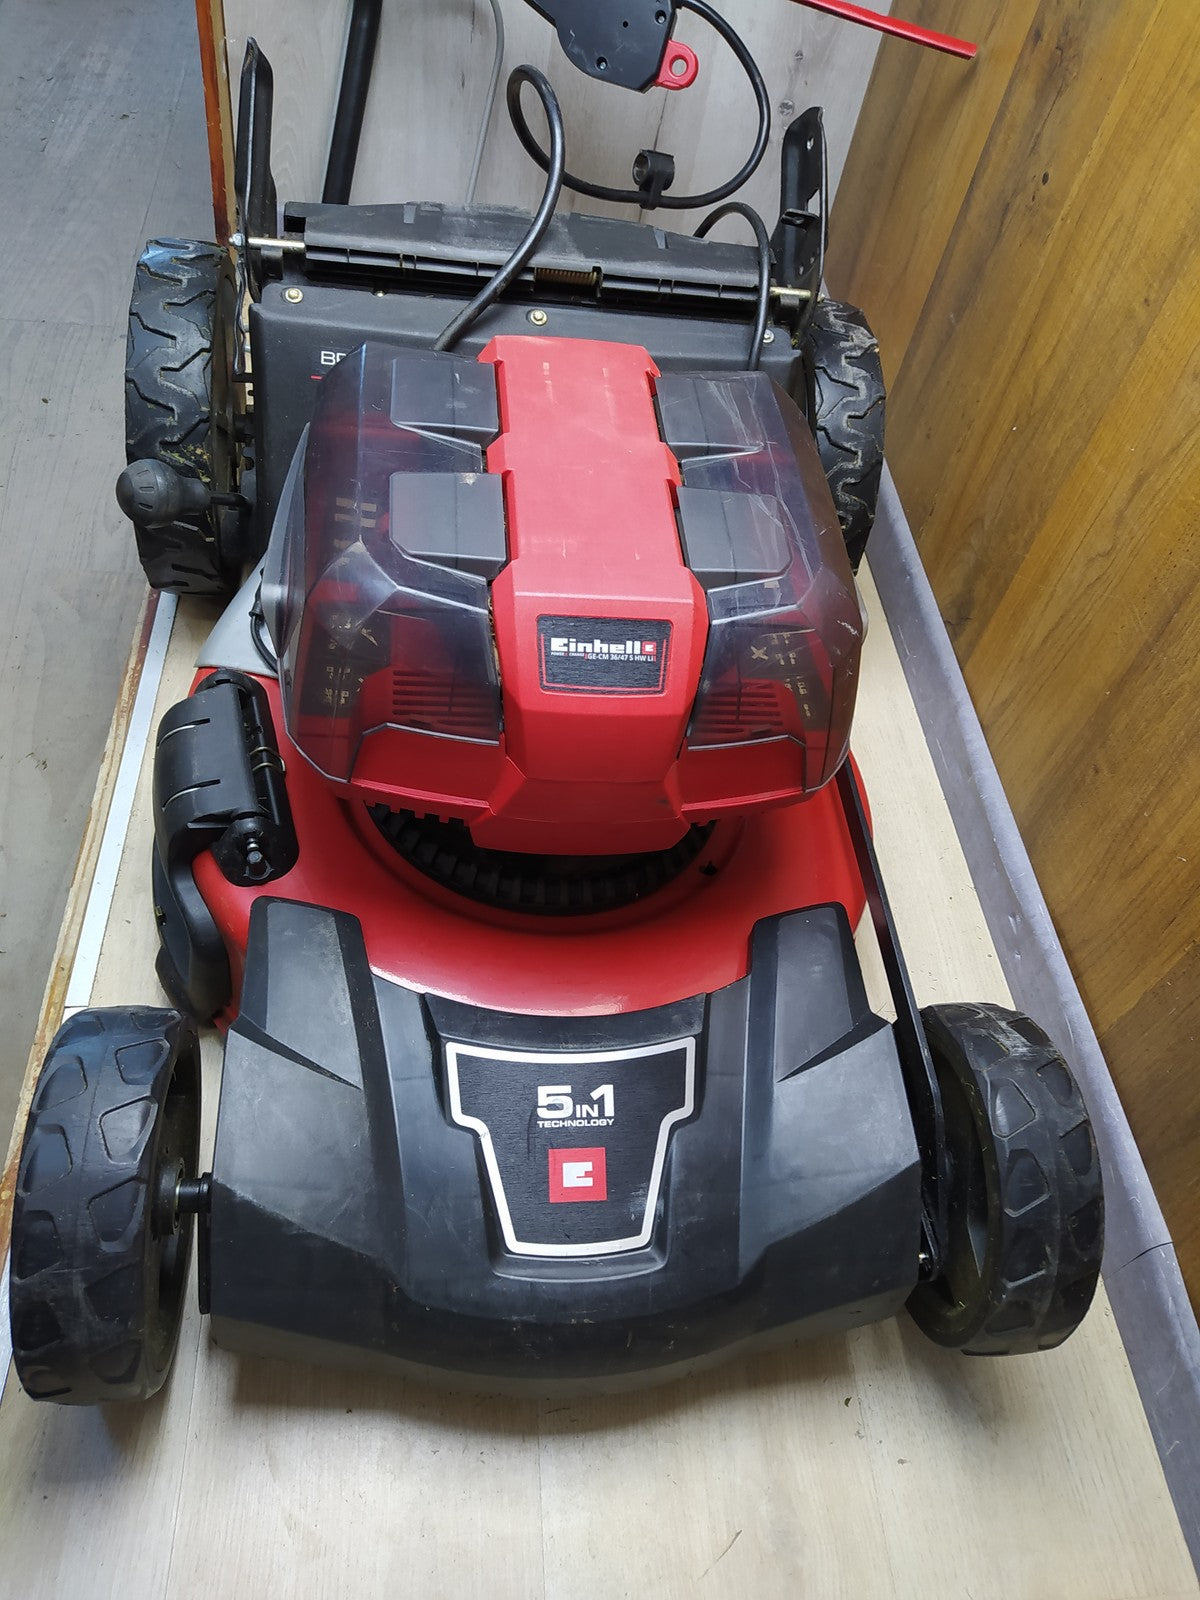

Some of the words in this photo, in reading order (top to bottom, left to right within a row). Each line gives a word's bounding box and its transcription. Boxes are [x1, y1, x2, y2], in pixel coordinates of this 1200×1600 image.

[550, 637, 641, 654] Einhell
[537, 1085, 573, 1119] 5
[576, 1104, 599, 1118] IN
[590, 1084, 615, 1117] 1
[537, 1118, 615, 1128] TECHNOLOGY
